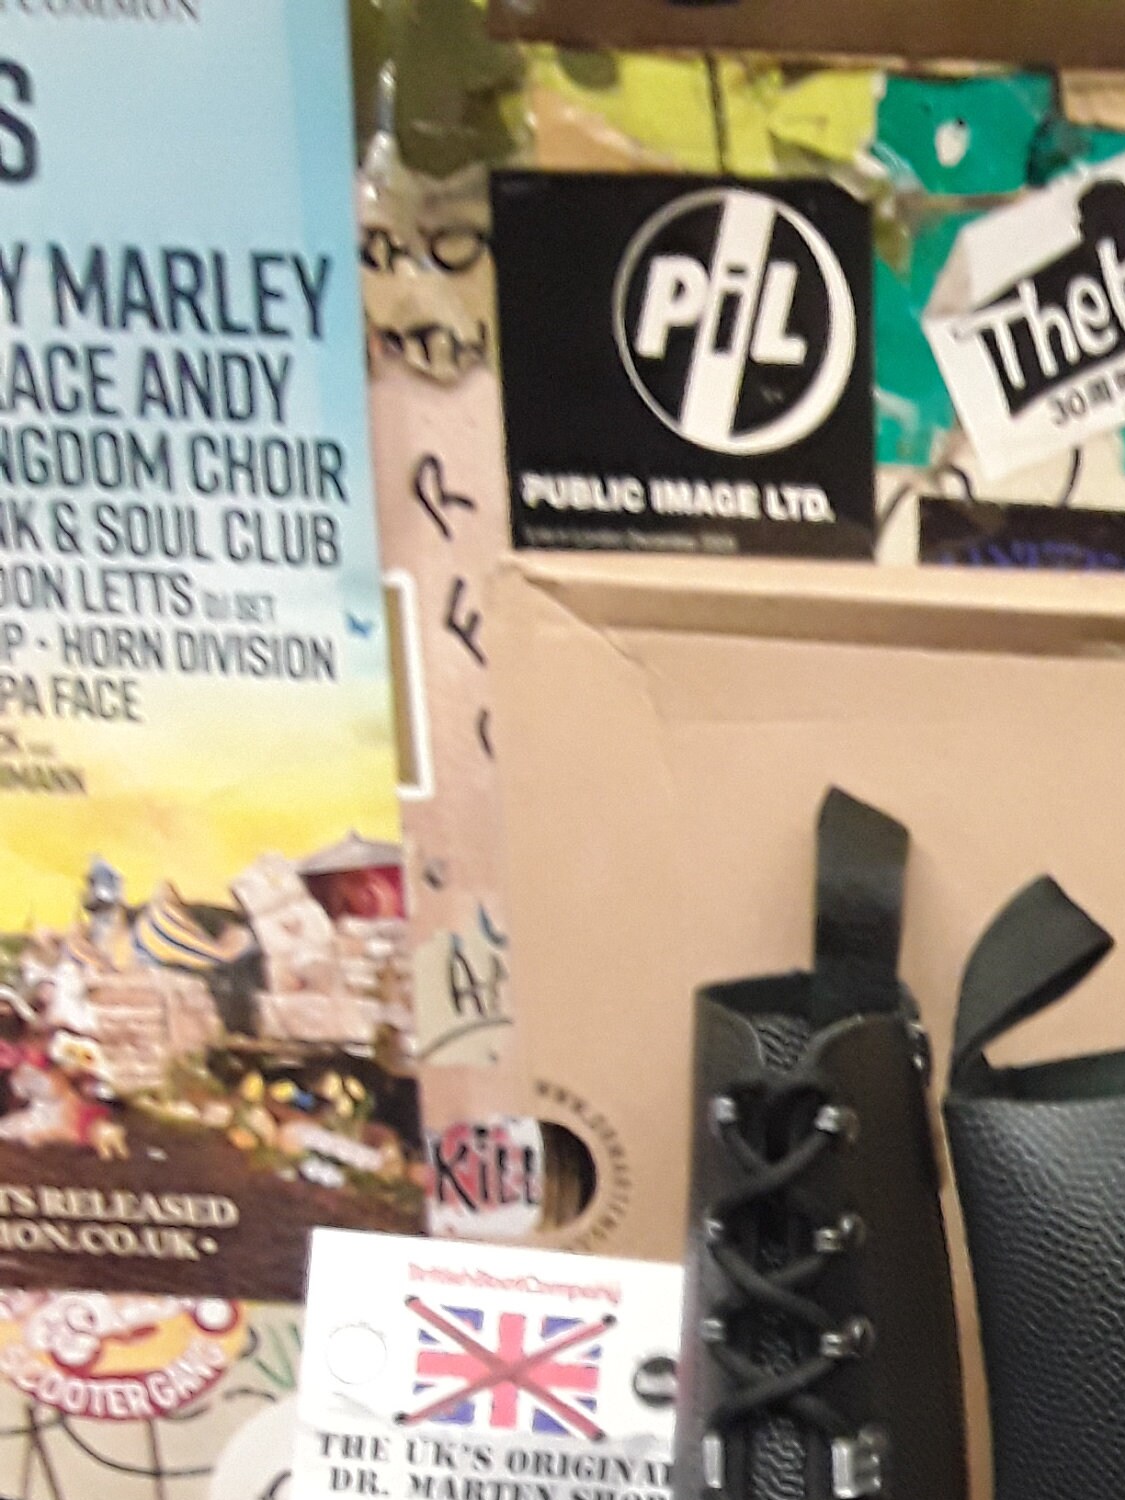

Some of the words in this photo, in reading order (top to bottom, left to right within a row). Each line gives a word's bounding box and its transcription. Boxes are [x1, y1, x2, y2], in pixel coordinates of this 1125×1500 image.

[48, 243, 331, 342] MARLEY
[0, 343, 117, 419] ACE
[139, 347, 292, 425] ANDY
[190, 433, 348, 503] CHOIR
[521, 472, 646, 514] PUBLIC
[650, 478, 760, 519] IMAGE
[764, 484, 836, 523] LTD.
[54, 502, 83, 554] &
[96, 503, 214, 562] SOUL
[224, 508, 342, 568] CLUB
[79, 566, 194, 617] LETTS
[60, 624, 165, 672] HORN
[175, 630, 338, 682] DIVISION
[52, 675, 146, 723] FACE
[38, 1184, 241, 1229] RELEASED
[318, 1432, 391, 1462] THE
[405, 1437, 492, 1471] UK'S
[329, 1467, 390, 1495] DR.
